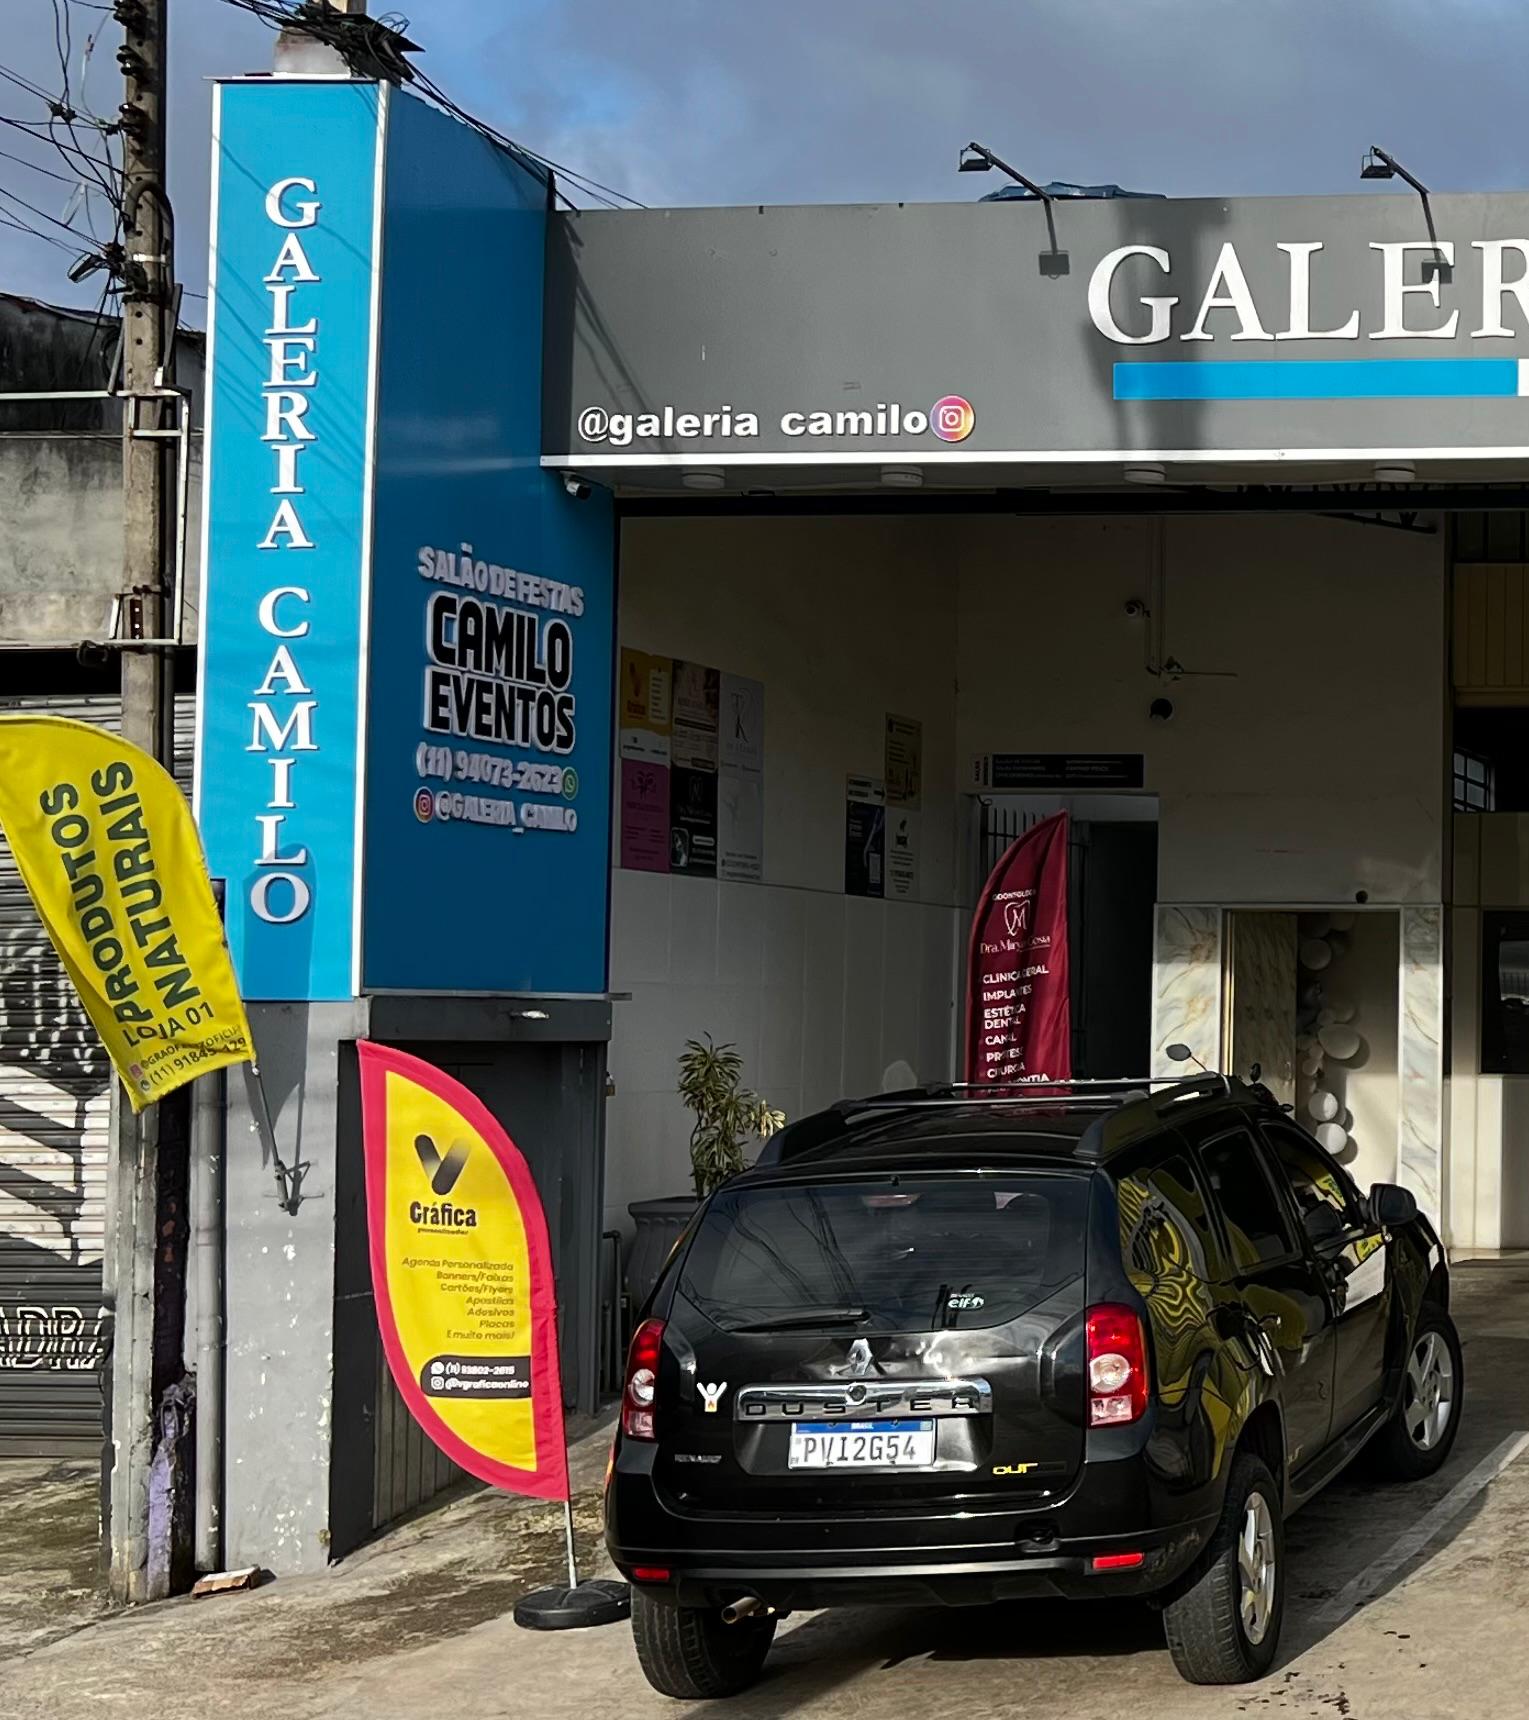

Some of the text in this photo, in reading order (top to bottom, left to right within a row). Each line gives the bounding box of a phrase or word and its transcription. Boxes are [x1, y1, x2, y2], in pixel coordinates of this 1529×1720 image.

[577, 403, 929, 445] @galeria camilo
[246, 177, 320, 924] GALERIA CAMILO
[418, 543, 585, 617] SALÃO DE FESTAS
[427, 590, 573, 692] CAMILO
[424, 665, 576, 755] EVENTOS
[40, 782, 154, 1024] PRODUTOS
[91, 760, 201, 1010] NATURAIS
[122, 1001, 214, 1048] LOJA 01
[149, 1064, 175, 1085] (11)
[410, 1201, 477, 1227] Gráfica
[479, 1319, 515, 1328] Placas
[745, 1397, 975, 1416] DUSTER
[804, 1435, 916, 1463] PVI2G54
